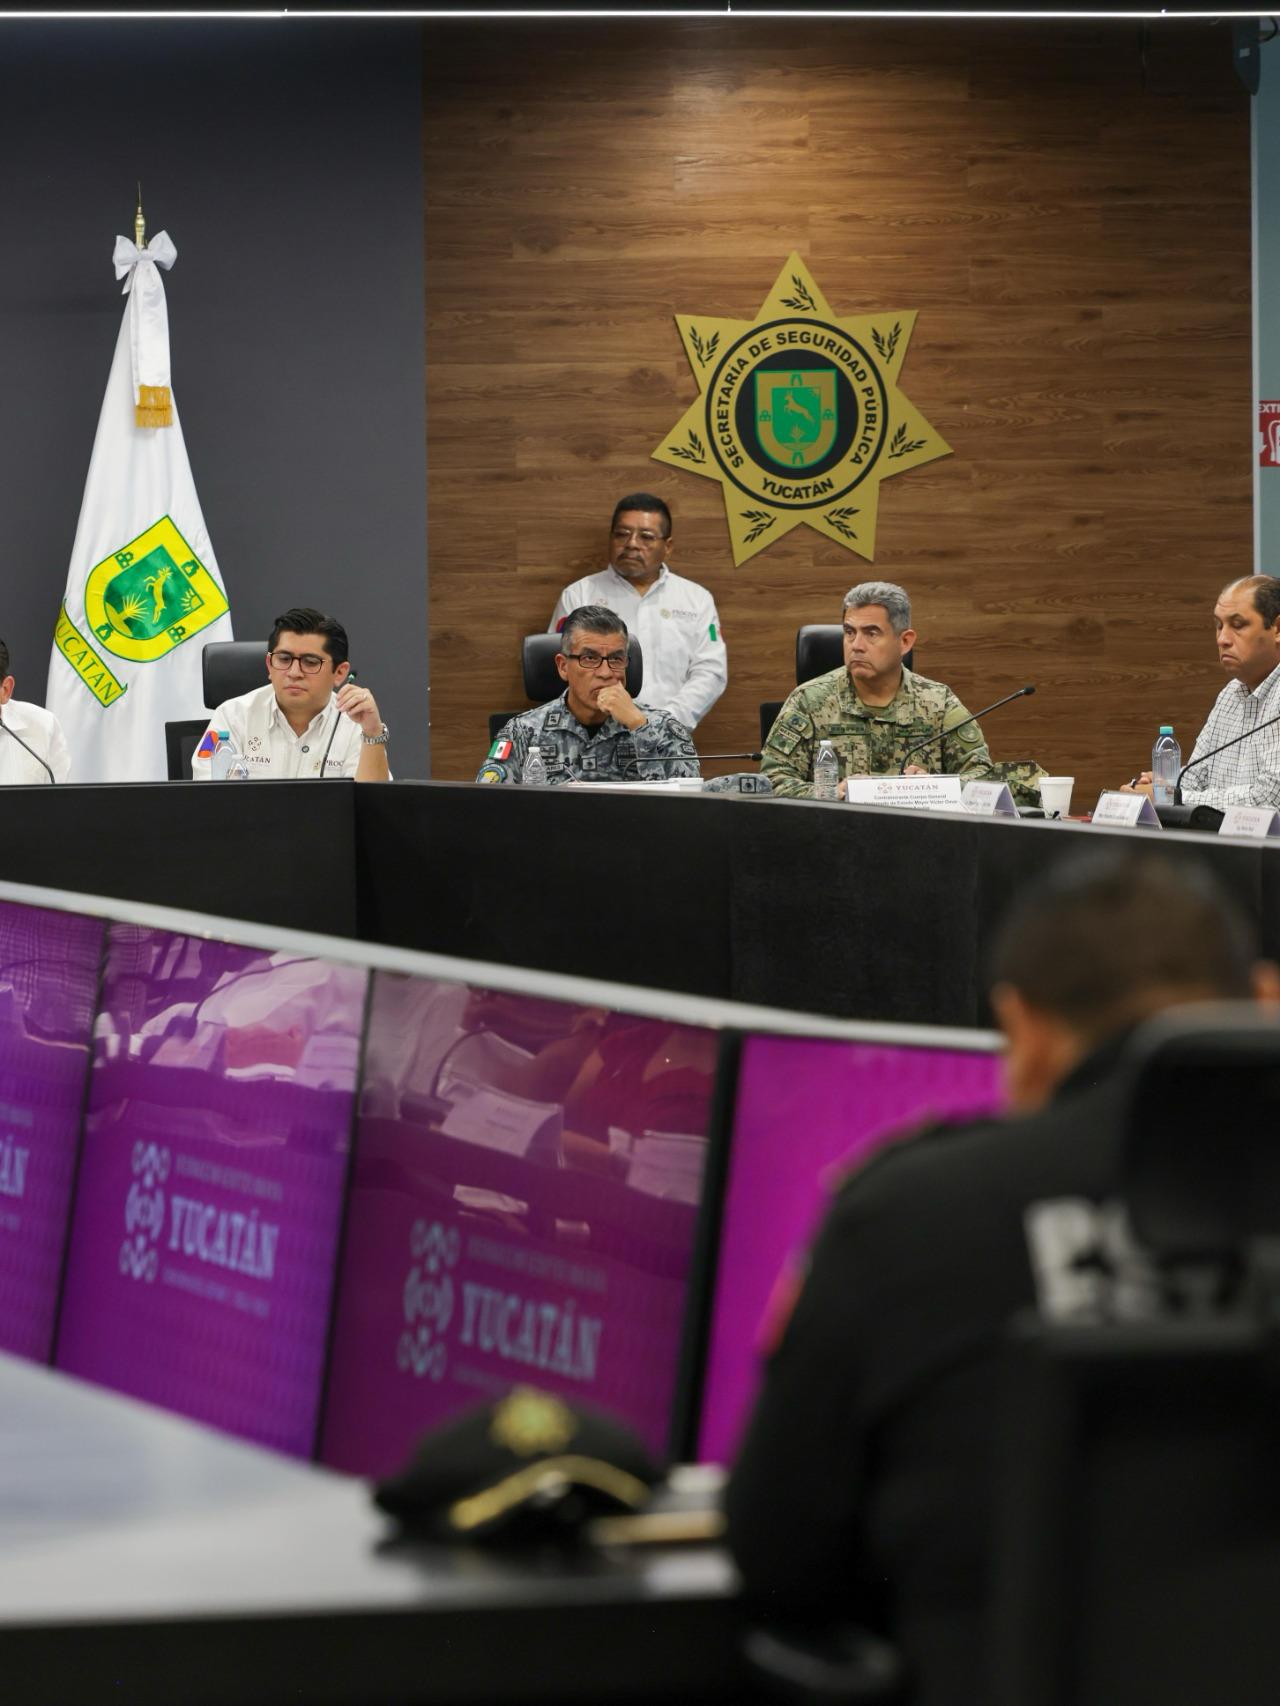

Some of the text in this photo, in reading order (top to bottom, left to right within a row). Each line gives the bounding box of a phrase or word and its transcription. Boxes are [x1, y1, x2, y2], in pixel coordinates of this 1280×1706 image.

[716, 330, 881, 469] SECRETARÍA DE SEGURIDAD PÚBLICA
[760, 477, 835, 500] YUCATÁN
[57, 612, 118, 700] UCATAN
[168, 1194, 280, 1281] YUCATÁN
[459, 1280, 603, 1382] YUCATÁN
